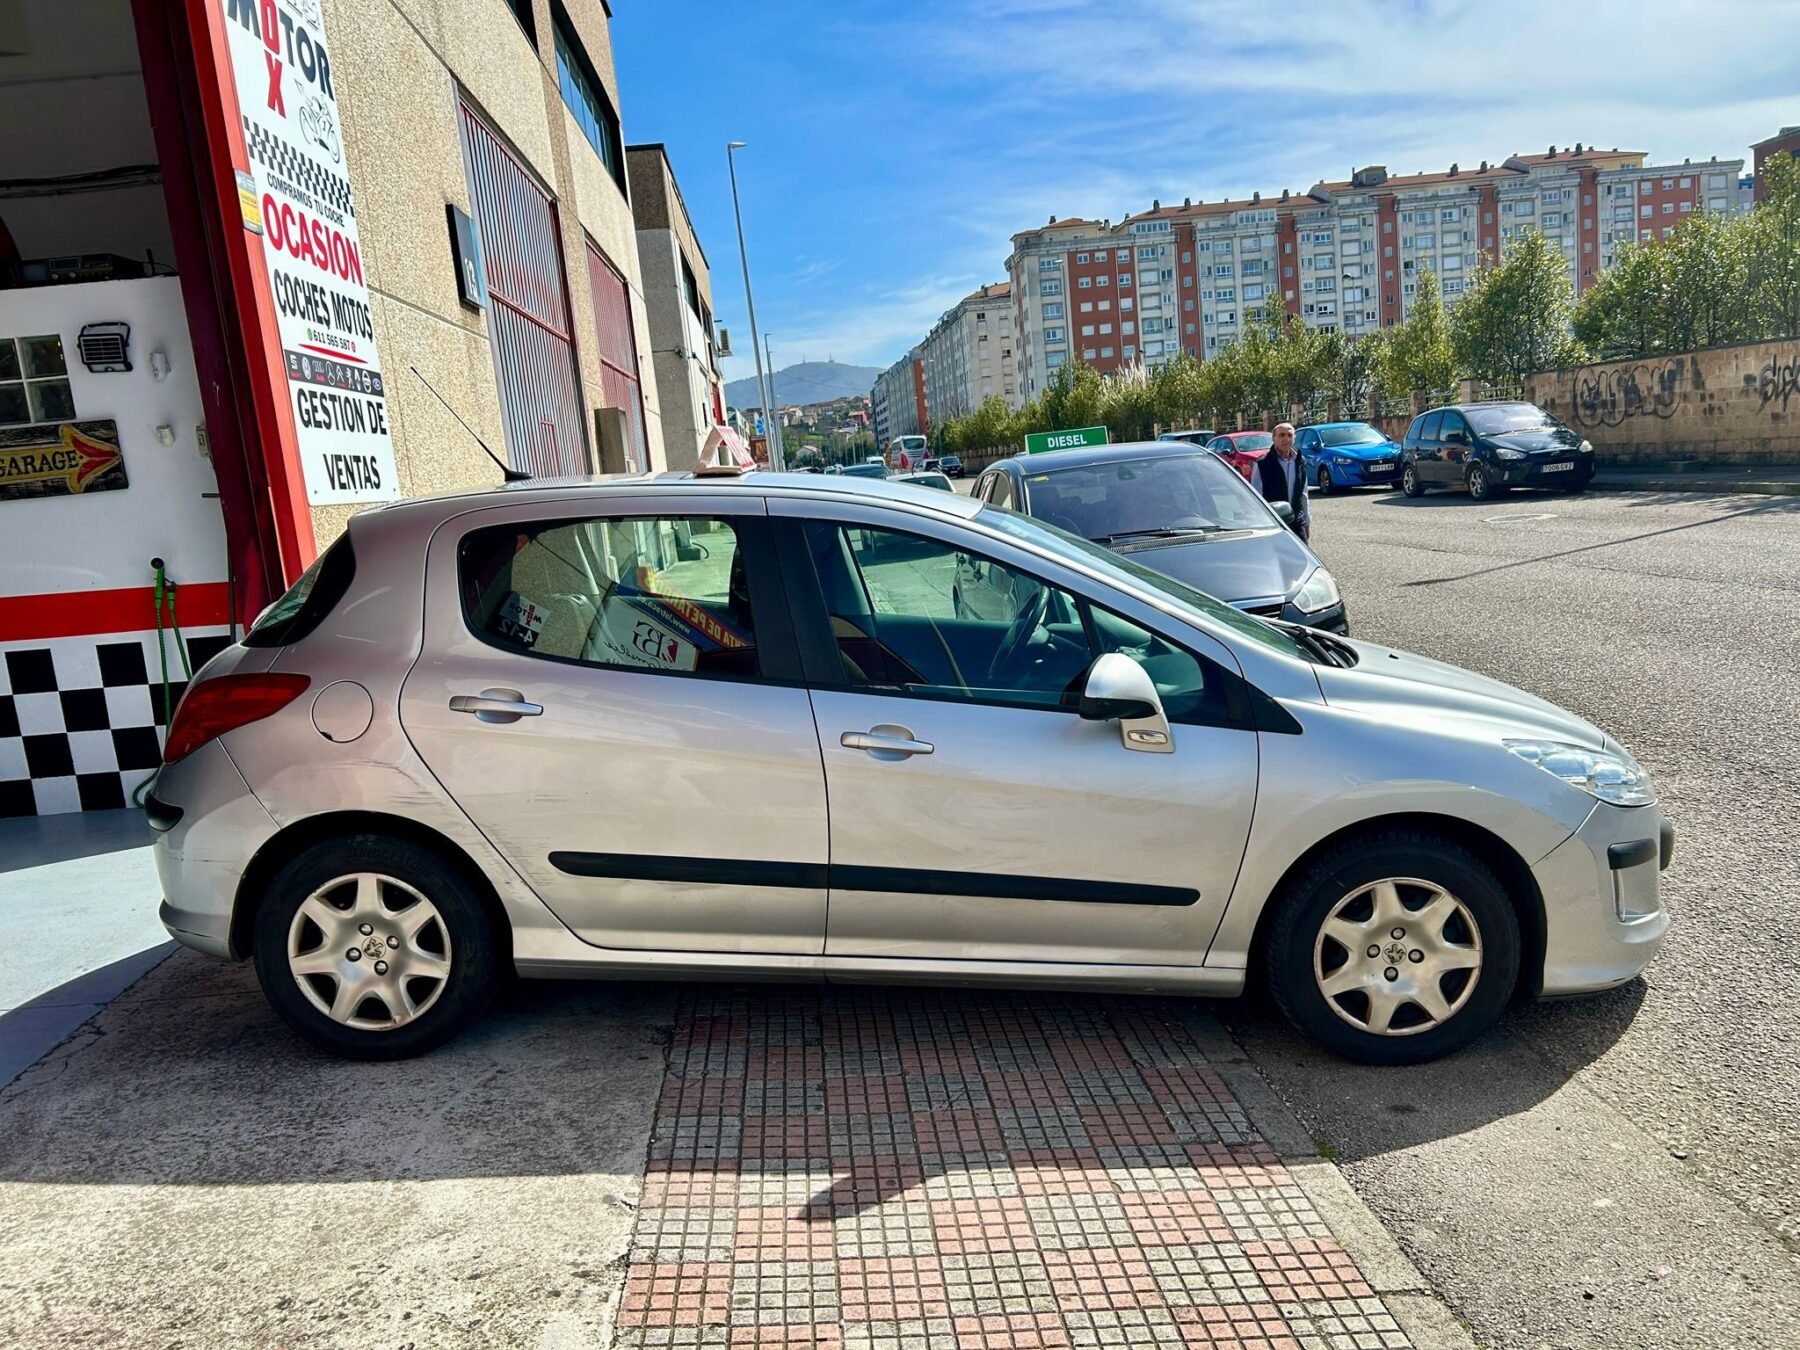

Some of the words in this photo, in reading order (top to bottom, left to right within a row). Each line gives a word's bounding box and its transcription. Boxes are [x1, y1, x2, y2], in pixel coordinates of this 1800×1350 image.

[260, 0, 287, 119] OX
[266, 172, 313, 209] COMPRAMOS
[314, 199, 324, 216] TU
[324, 204, 345, 228] COCHE
[262, 193, 364, 288] OCASION
[274, 269, 330, 329] COCHES
[330, 290, 373, 342] MOTOS
[313, 329, 326, 343] 611
[297, 388, 367, 433] GESTION
[366, 400, 388, 435] DE
[1047, 434, 1088, 448] DIESEL
[323, 453, 381, 490] VENTAS
